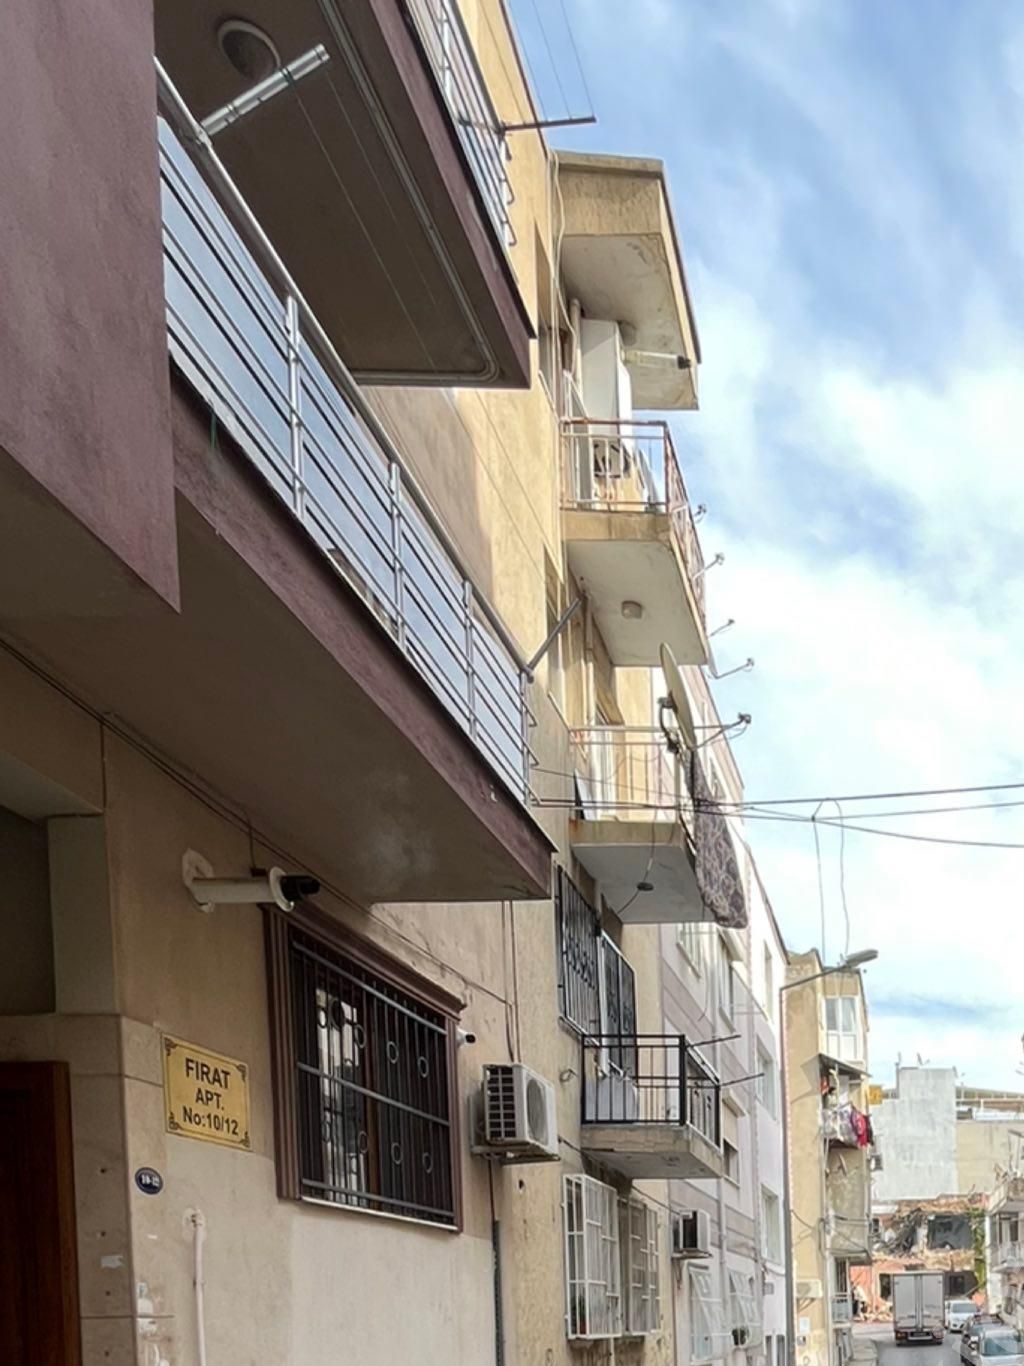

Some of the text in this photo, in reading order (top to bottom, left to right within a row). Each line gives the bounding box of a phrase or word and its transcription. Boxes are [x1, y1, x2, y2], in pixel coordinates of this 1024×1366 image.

[185, 1057, 231, 1089] FIRAT
[195, 1087, 225, 1111] APT.
[182, 1105, 239, 1136] No:10/12
